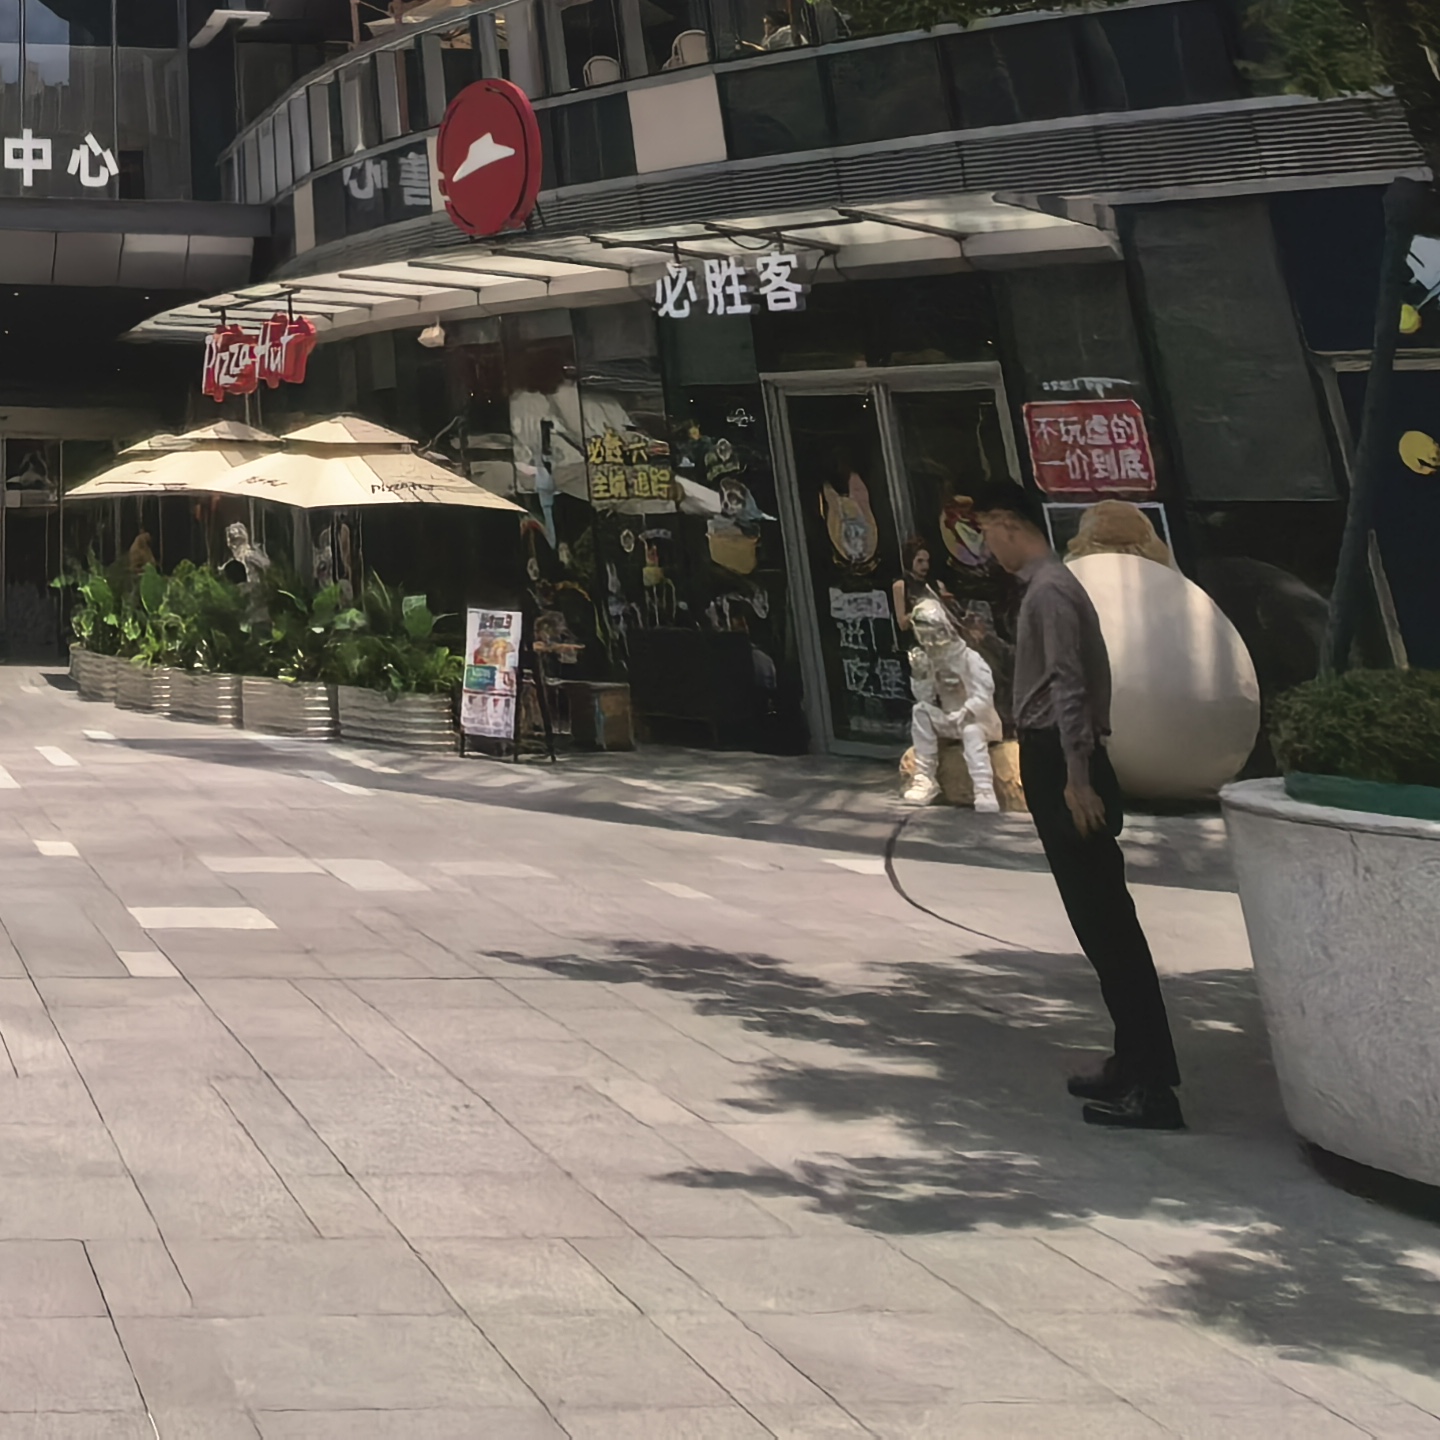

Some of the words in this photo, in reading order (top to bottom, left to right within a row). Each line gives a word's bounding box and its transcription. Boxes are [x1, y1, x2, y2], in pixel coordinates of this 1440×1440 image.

[655, 251, 802, 318] 必胜客
[202, 332, 253, 395] Pizza
[253, 320, 297, 379] Hut
[1033, 413, 1140, 446] 不玩虚的
[1038, 448, 1149, 481] 一价到底
